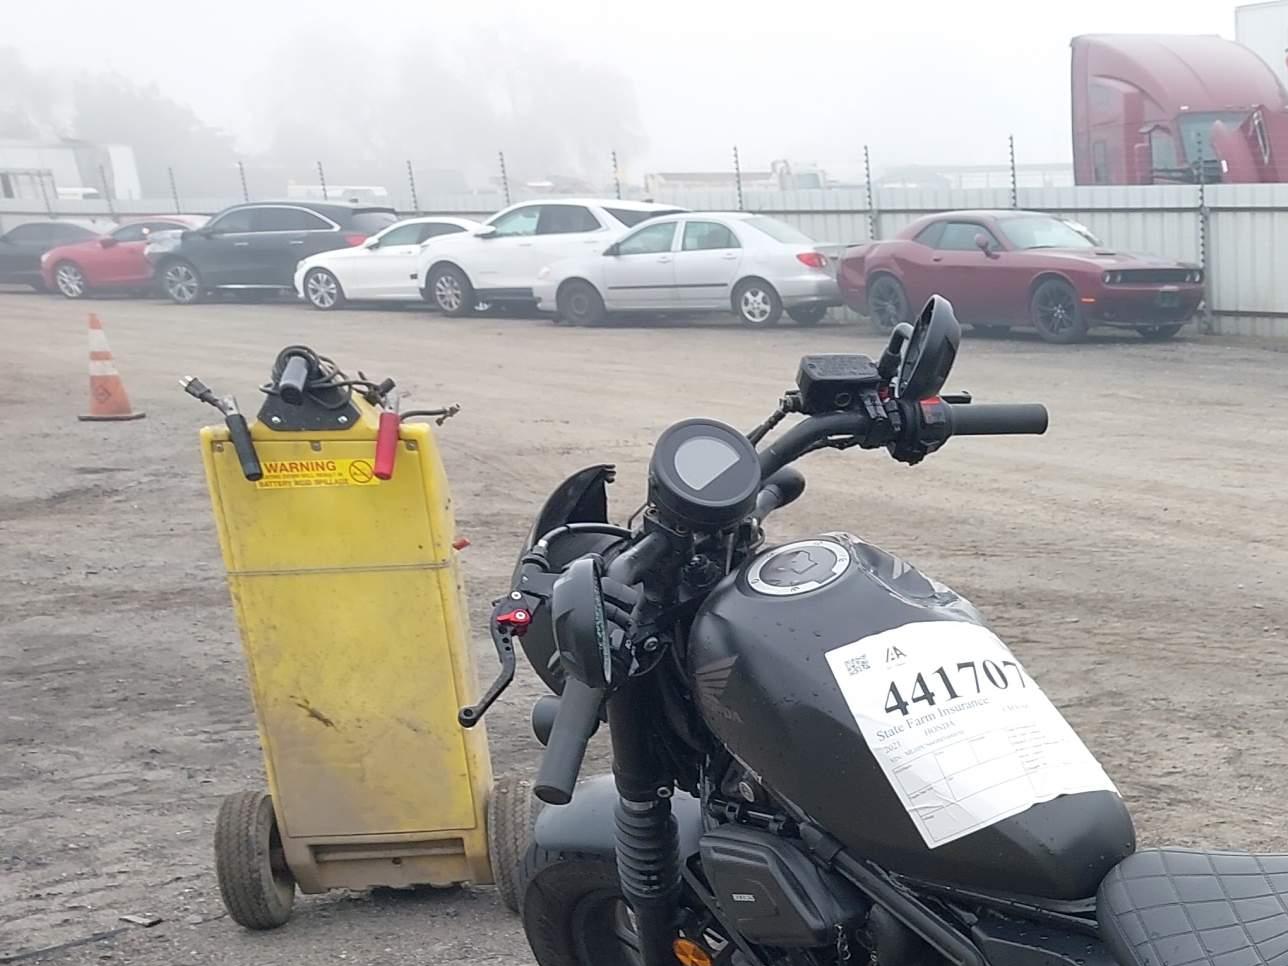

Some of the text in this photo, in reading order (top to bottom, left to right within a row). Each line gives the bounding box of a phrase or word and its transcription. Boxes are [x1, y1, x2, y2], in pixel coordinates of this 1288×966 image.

[264, 461, 337, 473] WARNING
[884, 659, 1026, 716] 441707
[876, 723, 905, 742] State
[905, 712, 937, 729] Farm
[936, 697, 990, 718] Insurance
